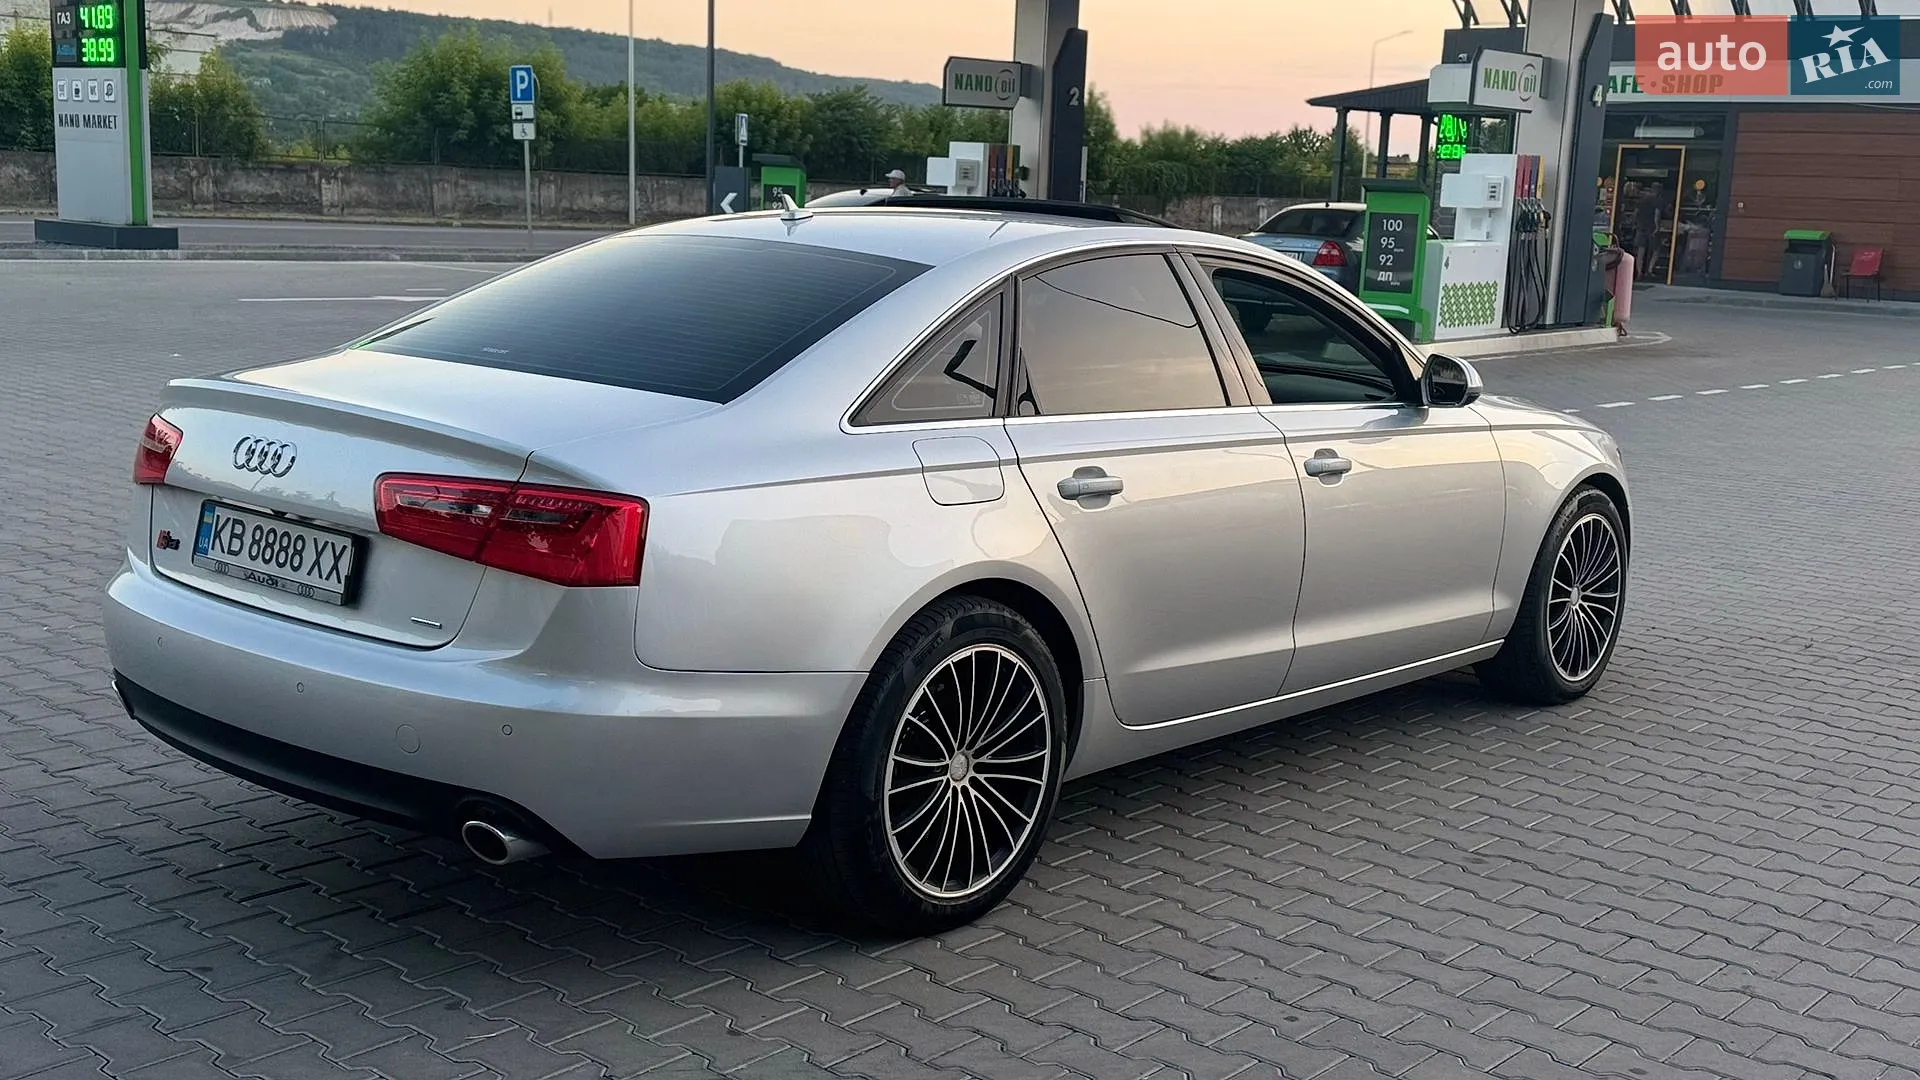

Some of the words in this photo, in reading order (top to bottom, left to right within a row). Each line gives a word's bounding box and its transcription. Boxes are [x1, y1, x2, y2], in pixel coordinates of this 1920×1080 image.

[57, 12, 70, 24] ГАЗ
[516, 70, 529, 98] P
[954, 73, 992, 93] NANO
[1483, 67, 1517, 91] NANO
[1606, 75, 1645, 94] AFE
[1661, 74, 1724, 94] SHOP
[1069, 87, 1080, 106] 2
[1592, 84, 1603, 107] 4
[58, 113, 80, 128] NANO
[83, 114, 118, 129] MARKET
[772, 186, 783, 197] 95
[1382, 219, 1403, 231] 100
[1380, 236, 1395, 248] 95
[1379, 254, 1393, 266] 92
[1377, 271, 1393, 282] ДП
[198, 537, 209, 549] UA
[211, 514, 247, 556] KB
[248, 524, 306, 572] 8888
[306, 537, 348, 584] XX
[248, 571, 280, 588] Audi
